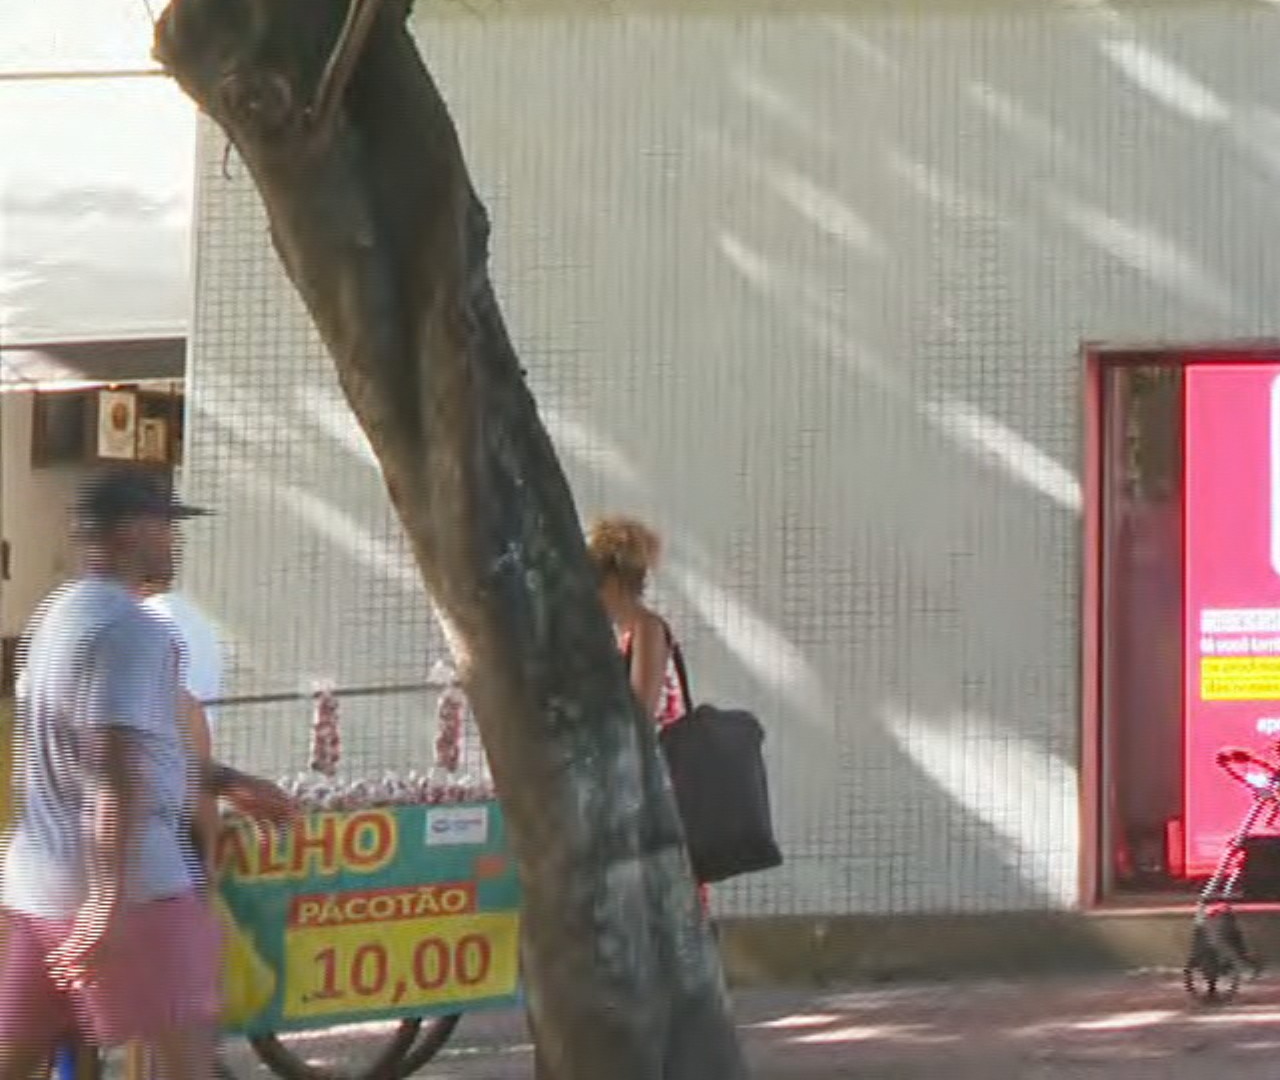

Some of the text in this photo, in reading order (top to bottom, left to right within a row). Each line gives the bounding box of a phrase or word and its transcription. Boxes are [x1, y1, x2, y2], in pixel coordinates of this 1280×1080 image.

[213, 808, 397, 877] ALHO
[300, 887, 467, 924] PACOTÃO
[313, 934, 491, 1003] 10,00
